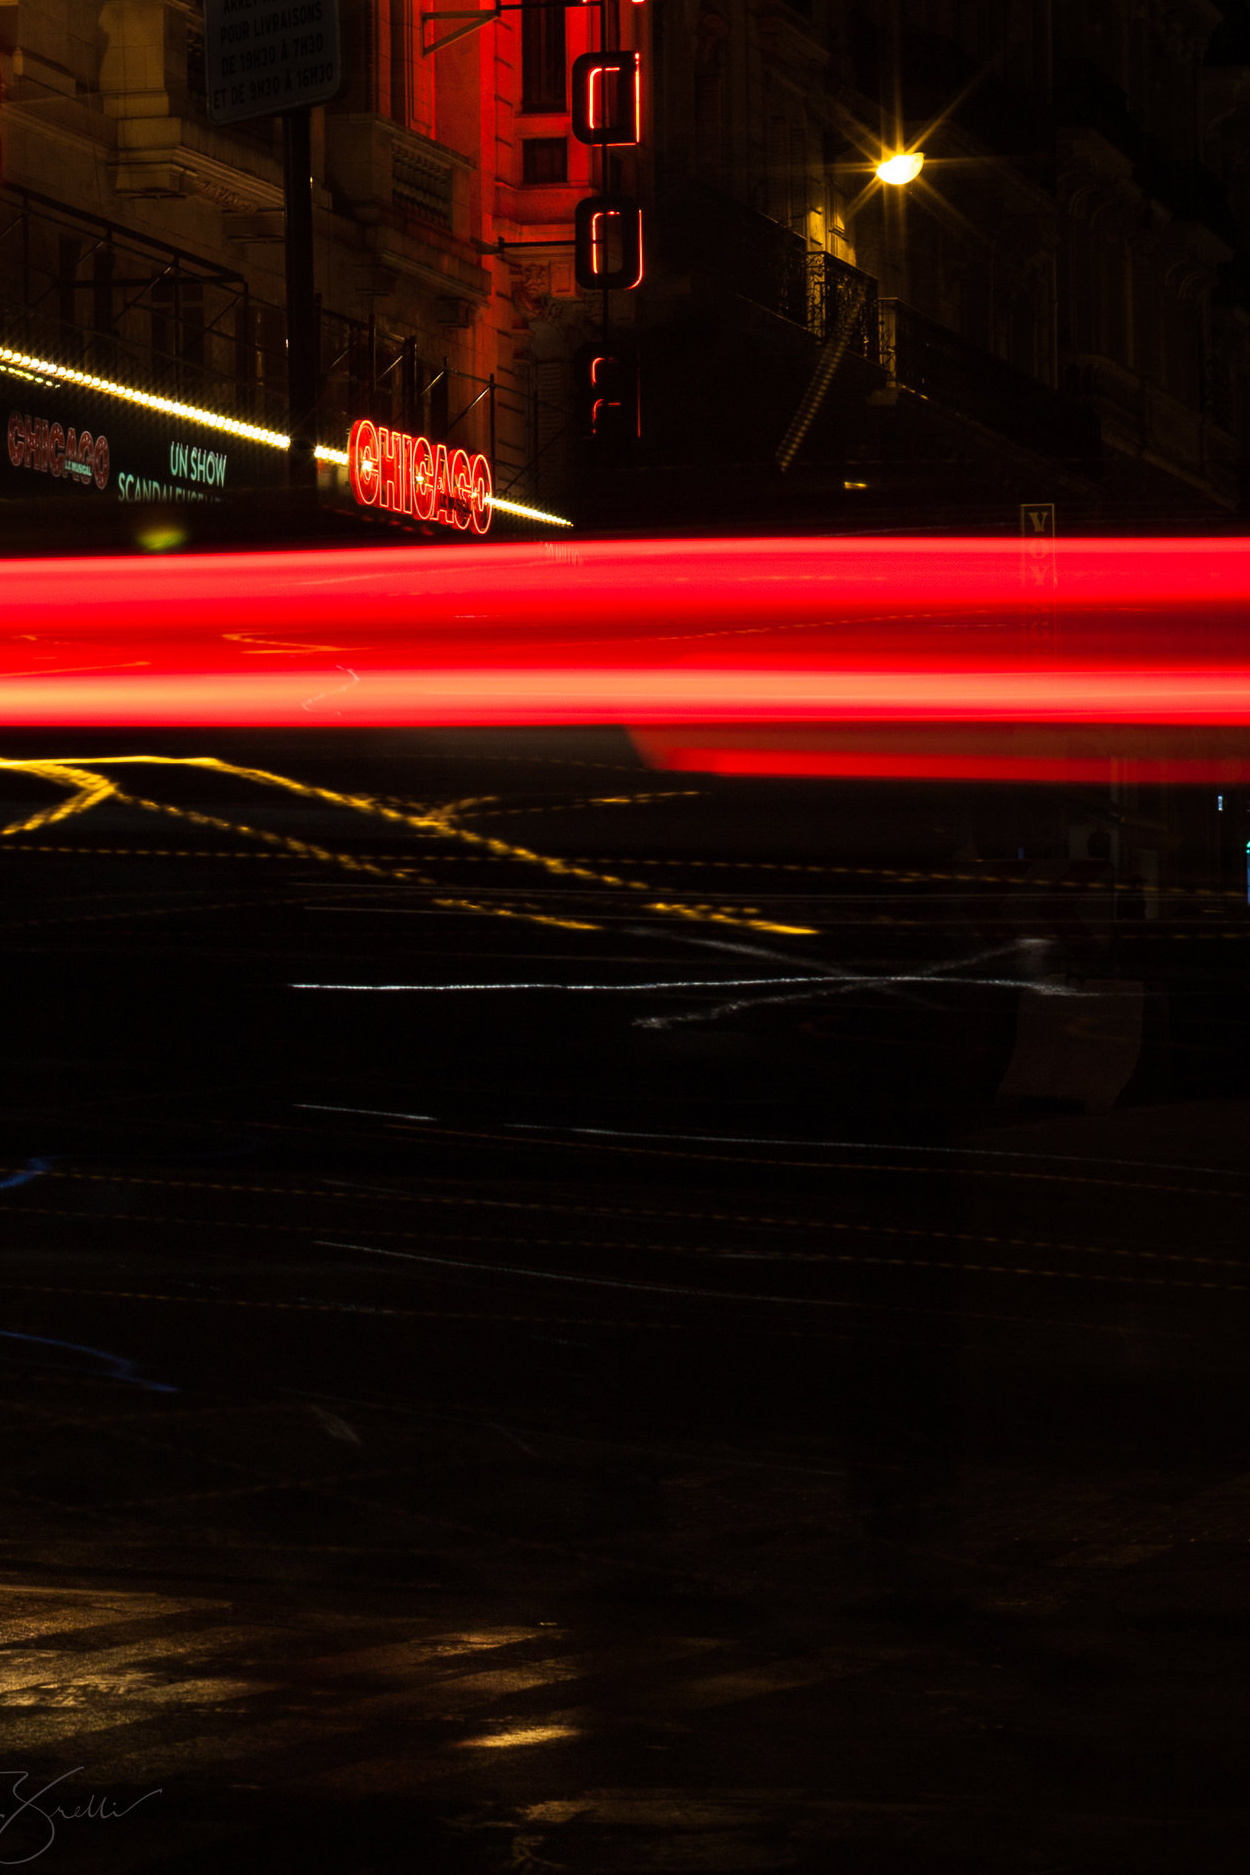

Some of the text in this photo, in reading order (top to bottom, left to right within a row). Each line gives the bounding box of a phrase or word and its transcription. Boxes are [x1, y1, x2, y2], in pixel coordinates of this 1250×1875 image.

[220, 1, 323, 45] POUR LIVRAISONS
[222, 56, 236, 77] DE
[240, 45, 276, 72] 19H30
[293, 33, 324, 58] 7H30
[213, 89, 227, 110] ET
[231, 84, 245, 105] DE
[250, 76, 280, 101] 9H30
[297, 62, 334, 89] 16H30
[7, 411, 110, 490] CHICAGO
[170, 441, 228, 488] UN SHOW
[351, 419, 493, 535] CHICAGO
